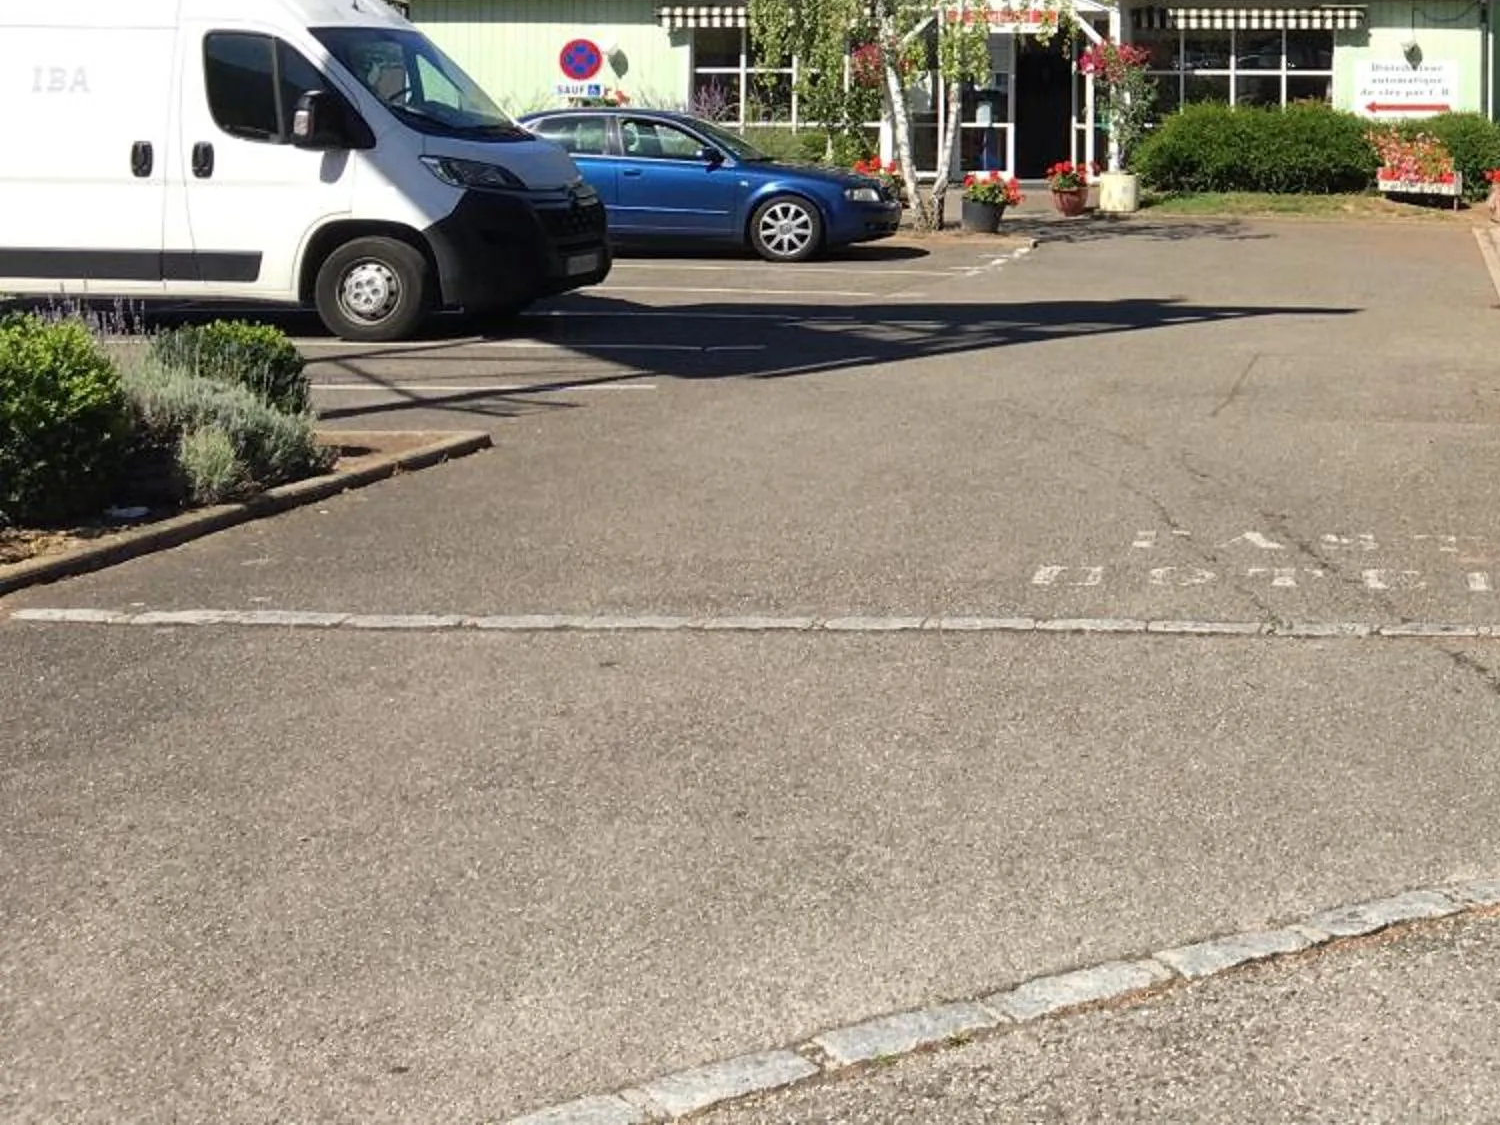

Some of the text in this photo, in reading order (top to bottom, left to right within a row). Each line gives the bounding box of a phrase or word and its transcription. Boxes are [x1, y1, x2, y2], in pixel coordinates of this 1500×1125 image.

[1371, 62, 1443, 72] Distribteur
[31, 66, 91, 93] IBA
[557, 84, 585, 94] SAUF
